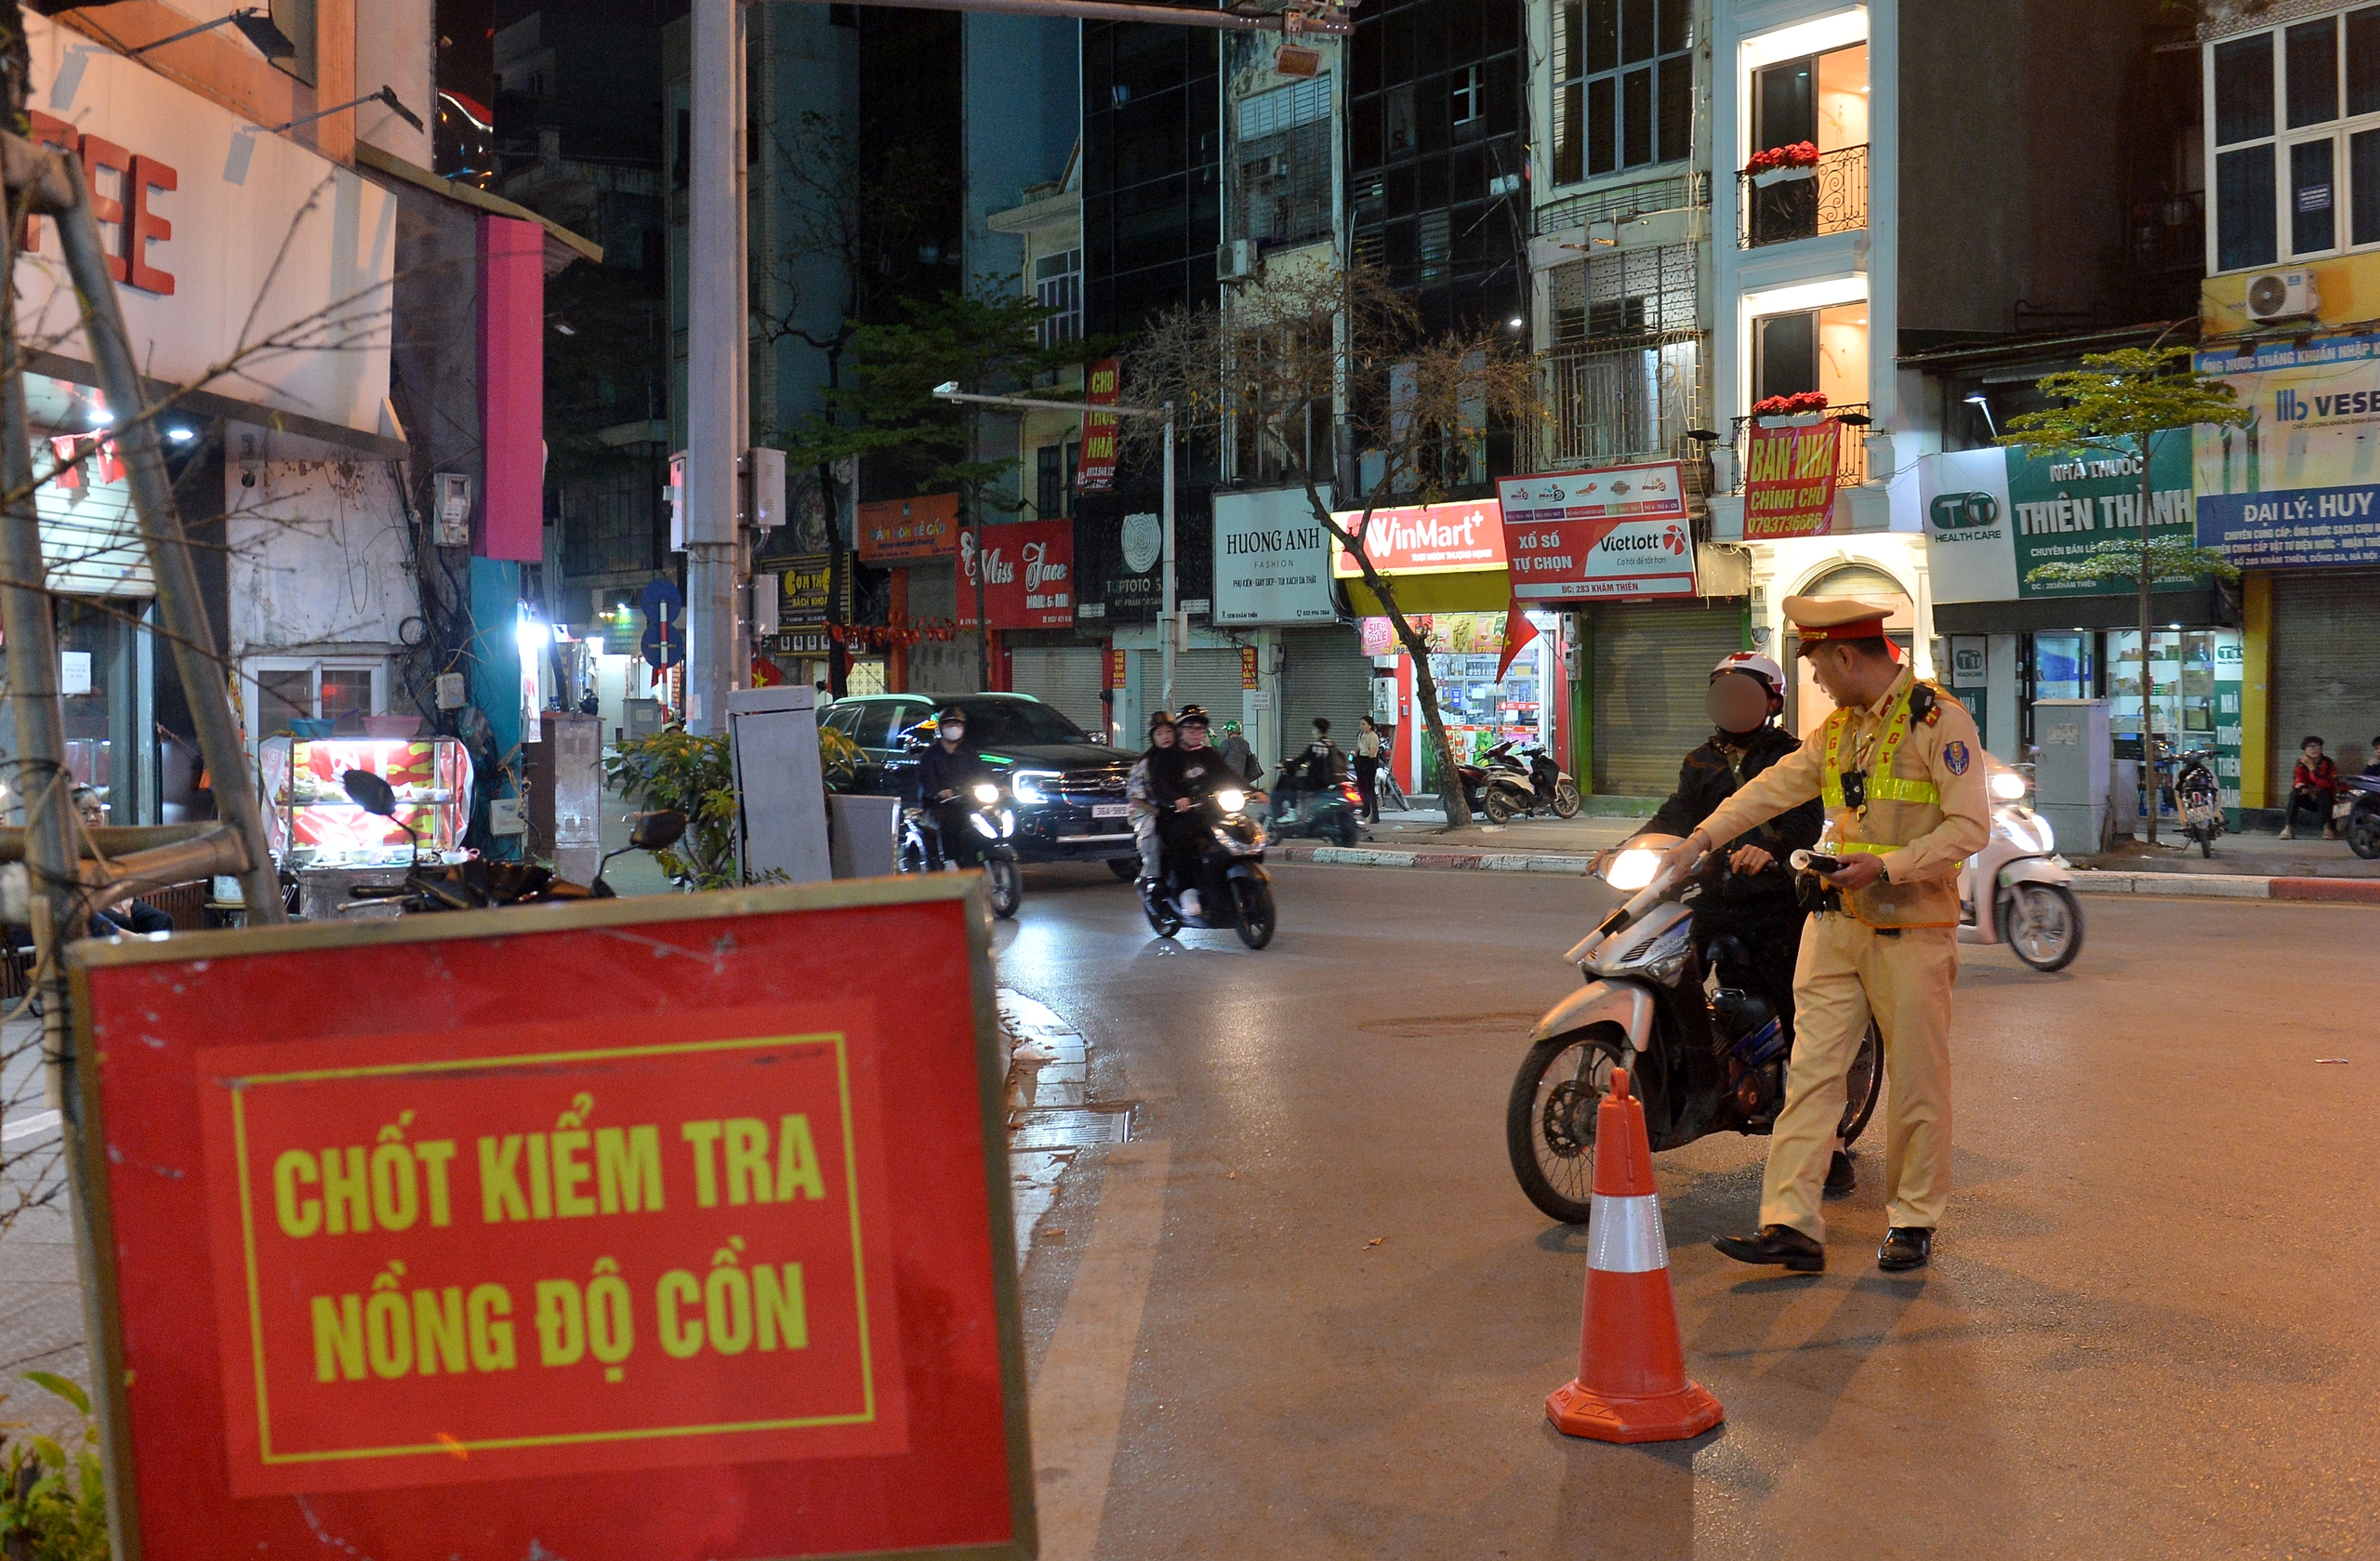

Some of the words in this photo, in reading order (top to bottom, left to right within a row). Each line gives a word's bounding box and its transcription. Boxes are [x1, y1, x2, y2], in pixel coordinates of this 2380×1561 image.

[2257, 350, 2295, 367] KHÁNG
[2297, 344, 2336, 363] KHUẨN
[2338, 341, 2370, 359] NHẬP
[1091, 370, 1115, 393] CHO
[1087, 431, 1113, 457] NHÀ
[1751, 430, 1792, 483] BÁN
[1795, 423, 1834, 480] NHÀ
[2050, 457, 2088, 483] NHÀ
[2090, 450, 2145, 478] THUỐC
[1751, 486, 1796, 510] CHÍNH
[1798, 479, 1827, 508] CHỦ
[2016, 491, 2096, 536] THIÊN
[2100, 483, 2192, 530] THÀNH
[2243, 503, 2278, 526] ĐẠI
[2283, 496, 2314, 520] LÝ:
[2320, 492, 2374, 518] HUY
[1226, 530, 1282, 555] HUONG
[1285, 527, 1320, 550] ANH
[1519, 531, 1538, 549] XỔ
[1541, 530, 1561, 548] SỐ
[1600, 533, 1659, 552] Vietlott
[1935, 533, 1973, 544] HEALTH
[1974, 530, 2002, 541] CARE
[960, 531, 1015, 586] Miss
[1023, 542, 1067, 592] Face
[2030, 546, 2065, 557] CHUYÊN
[2066, 544, 2084, 555] BÁN
[2233, 555, 2244, 565] SỐ
[2260, 554, 2283, 563] KHÂM
[2349, 551, 2361, 561] HÀ
[1254, 560, 1294, 569] FASHION
[1514, 558, 1531, 573] TỰ
[1534, 555, 1573, 572] CHỌN
[1562, 585, 1575, 594] ĐC:
[1576, 585, 1590, 593] 283
[1592, 582, 1615, 592] KHÂM
[1617, 581, 1639, 591] THIÊN
[1366, 630, 1388, 645] SALE
[2221, 691, 2240, 713] NHÀ
[1883, 713, 1908, 764] SGT
[2216, 721, 2242, 745] THUỐC
[2218, 754, 2241, 776] THIÊN
[272, 1109, 455, 1239] CHỐT
[478, 1092, 664, 1224] KIỂM
[681, 1113, 824, 1209] TRA
[311, 1260, 516, 1383] NỒNG
[536, 1257, 634, 1382] ĐỘ
[655, 1236, 809, 1360] CỒN
